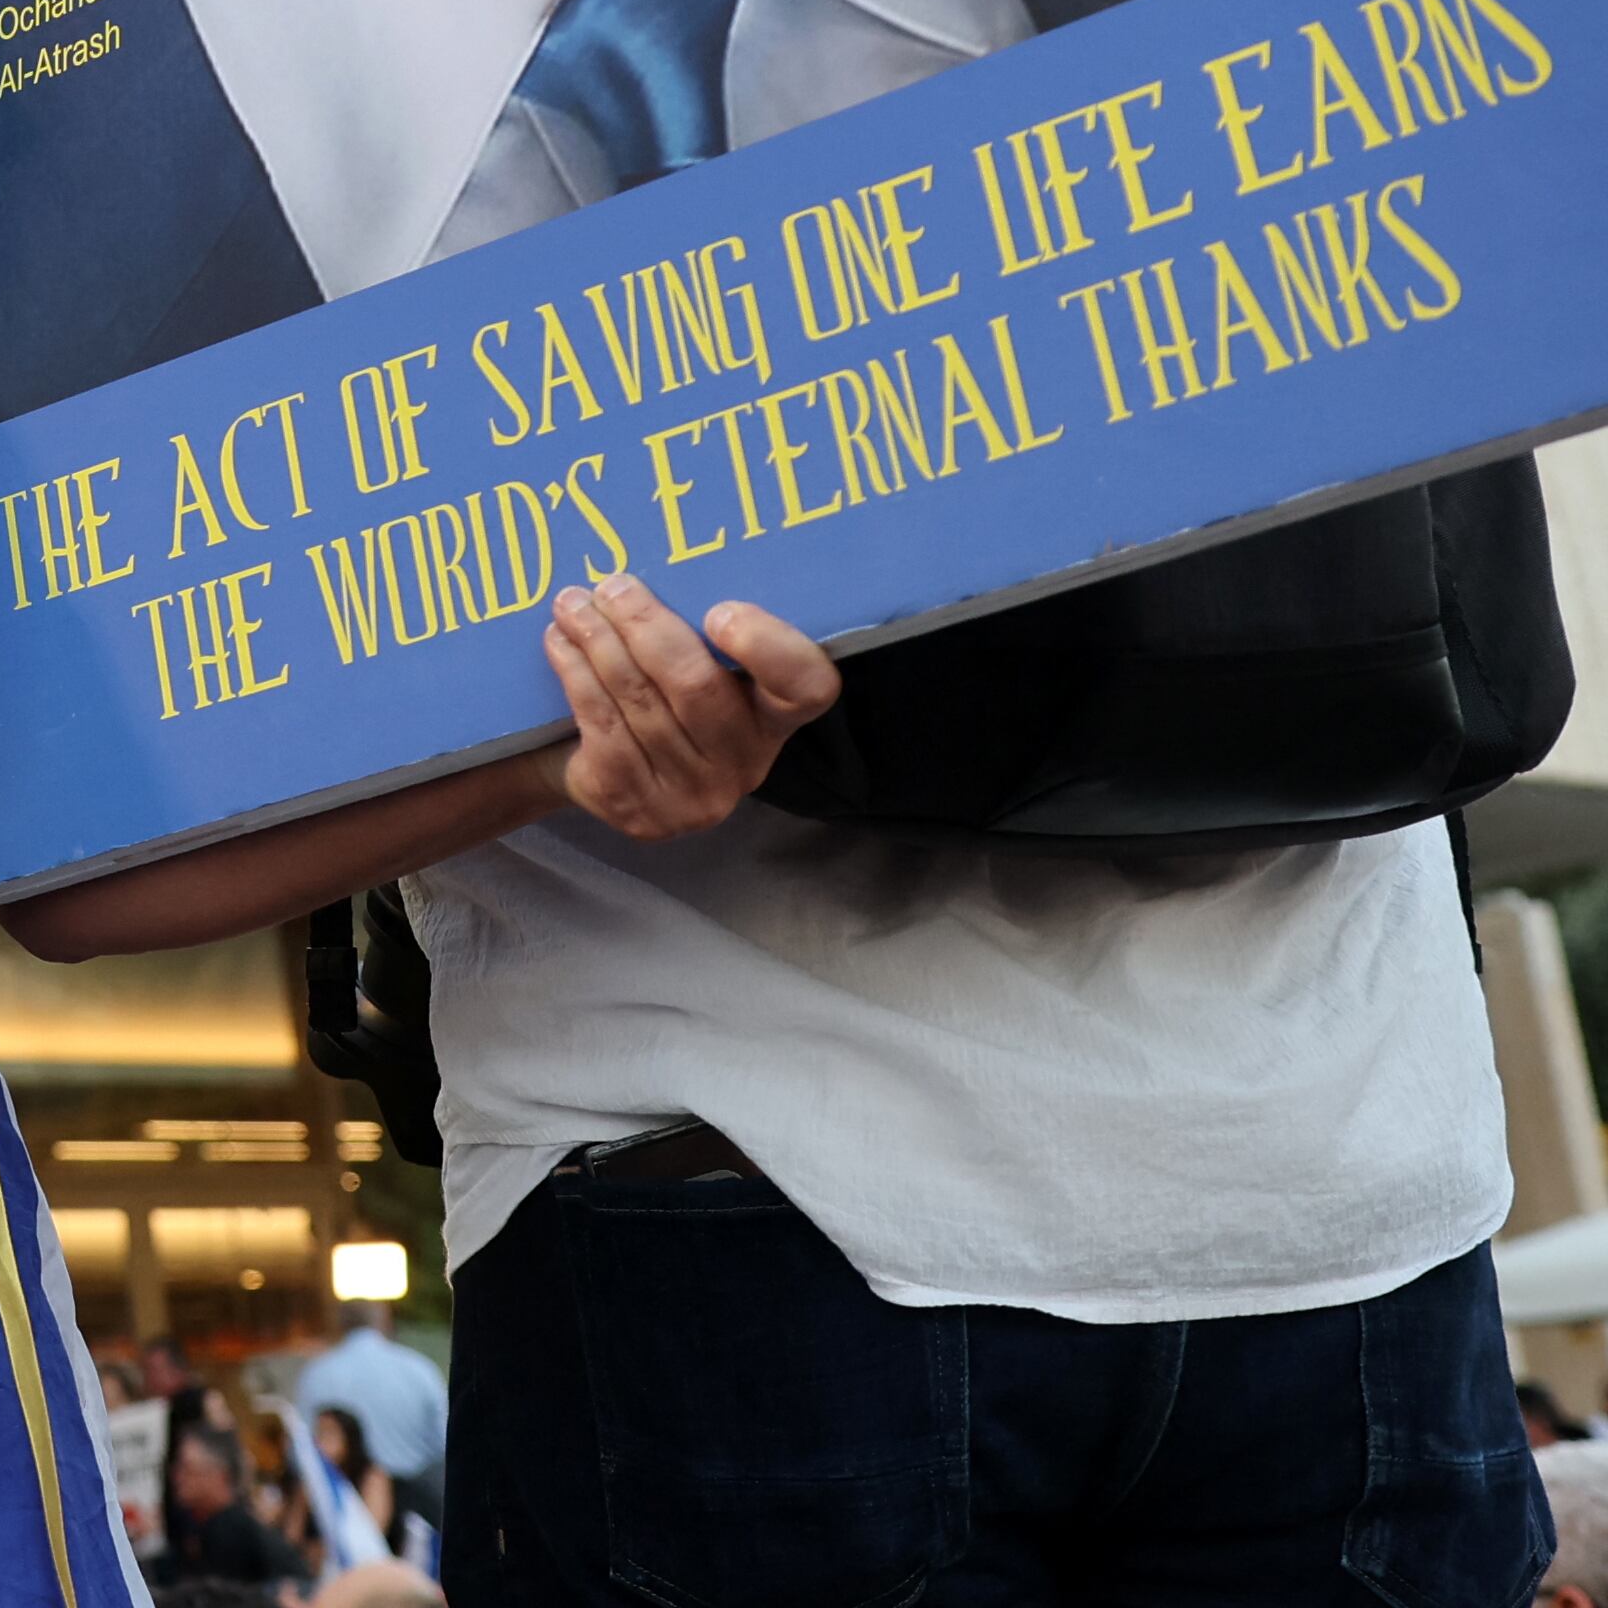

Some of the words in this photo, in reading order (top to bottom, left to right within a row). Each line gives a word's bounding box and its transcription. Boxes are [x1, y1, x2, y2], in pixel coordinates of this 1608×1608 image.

[132, 562, 290, 720] THE
[304, 452, 631, 666] WORLD'S
[643, 313, 1063, 566] ETERNAL
[1059, 173, 1463, 425] THANKS
[169, 393, 313, 560] ACT
[340, 344, 438, 495] OF
[471, 235, 773, 448] SAVING
[780, 165, 962, 342] ONE
[973, 81, 1194, 277] LIFE
